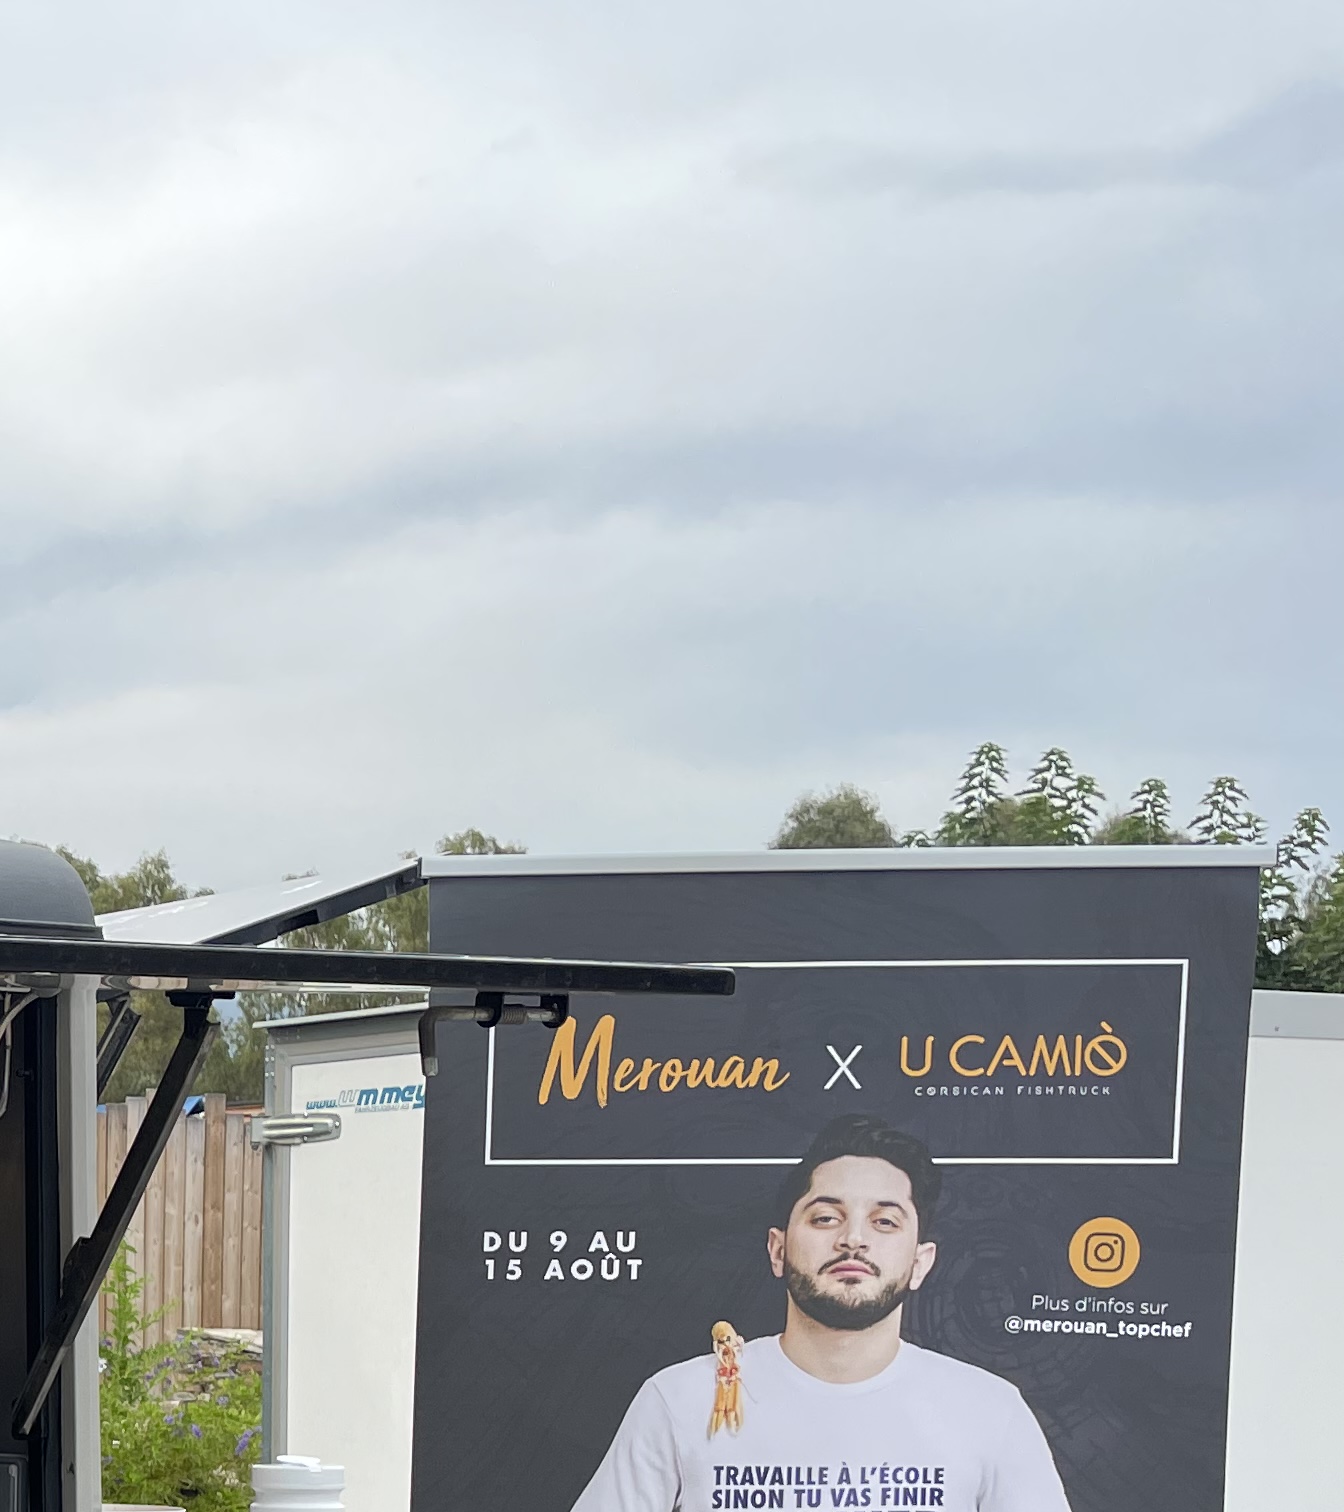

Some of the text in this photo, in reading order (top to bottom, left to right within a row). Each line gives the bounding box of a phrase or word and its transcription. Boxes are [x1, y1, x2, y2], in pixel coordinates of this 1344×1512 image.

[538, 1014, 790, 1109] Merouan
[900, 1035, 935, 1077] U
[949, 1020, 1128, 1077] CAMIÒ
[914, 1085, 1111, 1096] CORSICAN FISHTRUCK
[482, 1230, 639, 1253] DU 9 AU
[484, 1253, 644, 1282] 15 AOÛT
[1031, 1294, 1169, 1315] Plus d'infos sur
[1004, 1315, 1193, 1338] @merouan_topchef
[713, 1461, 945, 1486] TRAVAILLE À L'ÉCOLE
[711, 1487, 944, 1510] SINON TU VAS FINIR
